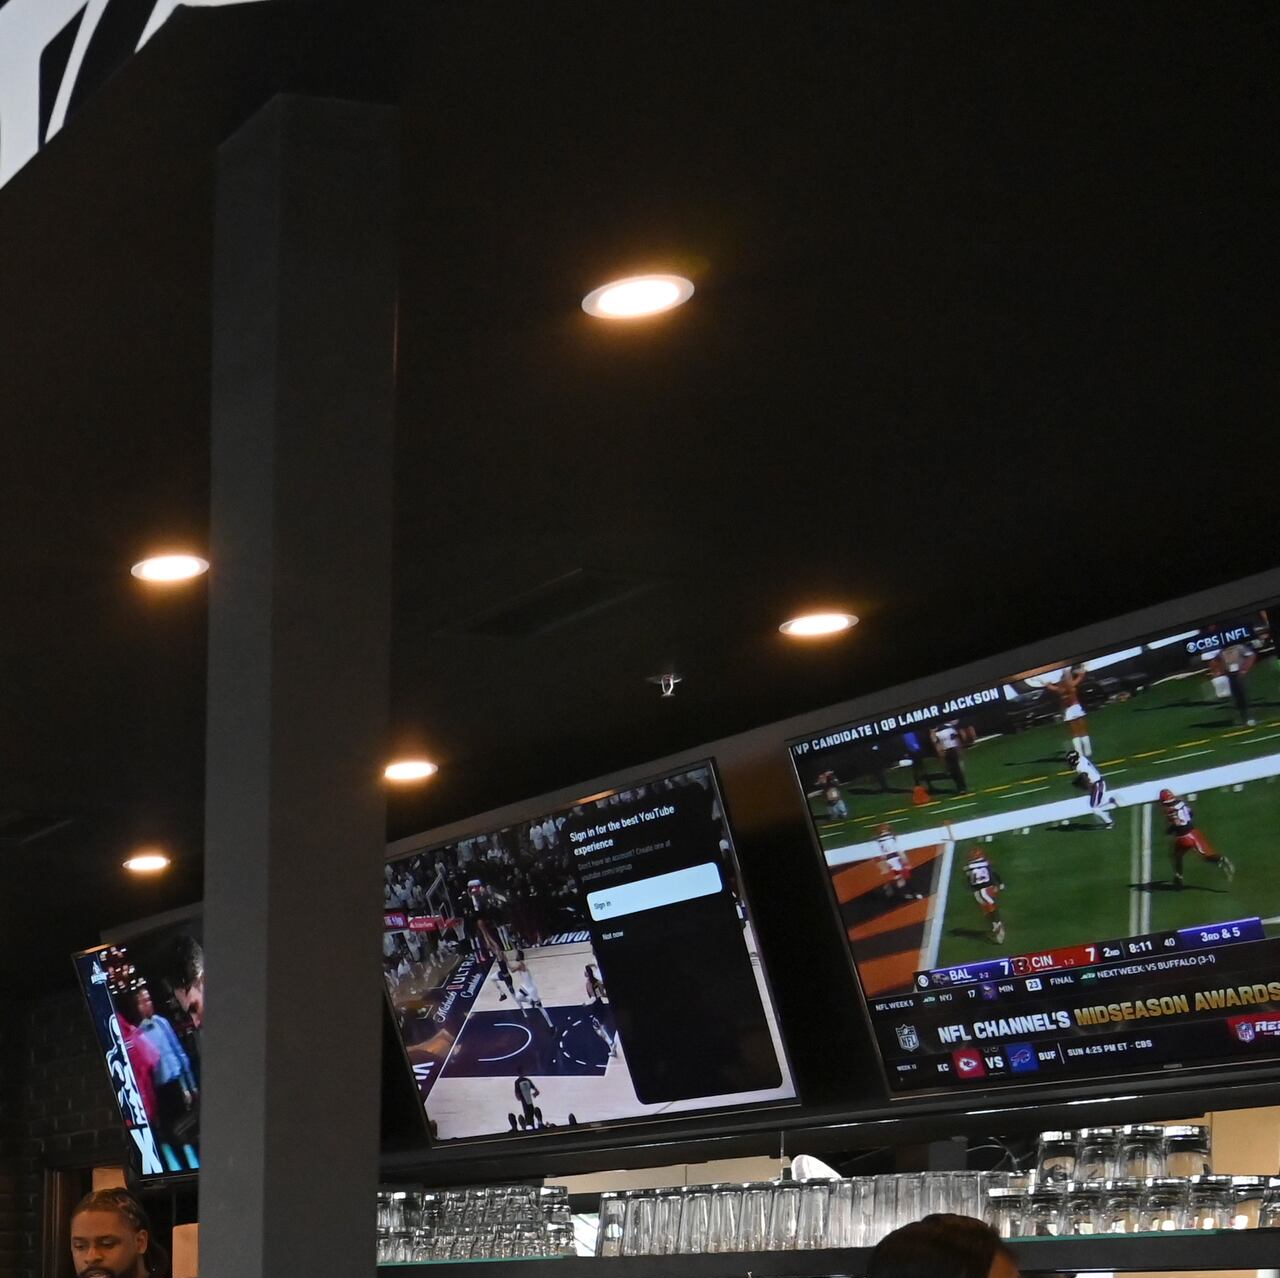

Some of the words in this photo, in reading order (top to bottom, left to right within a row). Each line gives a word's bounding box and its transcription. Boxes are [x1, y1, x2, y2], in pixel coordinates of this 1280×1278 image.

[1196, 635, 1219, 650] CBS
[1225, 627, 1250, 642] NFL
[812, 722, 873, 750] CANDIDATE
[880, 715, 897, 731] QB
[898, 704, 939, 727] LAMAR
[942, 687, 1000, 713] JACKSON
[570, 831, 587, 842] Sign
[587, 828, 596, 837] in
[595, 825, 607, 835] for
[607, 820, 621, 831] the
[621, 815, 639, 828] best
[639, 805, 675, 822] YouTube
[573, 838, 614, 857] experience
[1221, 928, 1232, 939] &
[1233, 926, 1241, 937] 5
[1128, 940, 1153, 954] 8:11
[1163, 937, 1176, 948] 40
[1031, 954, 1054, 969] CIN
[1085, 946, 1097, 963] 7
[1097, 968, 1120, 979] NEXT
[1145, 961, 1158, 972] VS
[1157, 956, 1198, 971] BUFFALO
[1198, 953, 1217, 966] (3-1)
[949, 966, 972, 982] BAL
[999, 960, 1011, 976] 7
[998, 984, 1014, 994] MIN
[1050, 975, 1075, 987] FINAL
[967, 989, 977, 999] 17
[875, 1001, 889, 1012] NFL
[889, 1000, 910, 1010] WEEK
[1074, 994, 1190, 1026] MIDSEASON
[1195, 982, 1280, 1011] AWARDS
[938, 1025, 972, 1044] NFL
[974, 1011, 1071, 1039] CHANNEL'S
[1038, 1049, 1057, 1061] BUF
[1067, 1047, 1085, 1058] SUN
[1084, 1044, 1103, 1055] 4:25
[1103, 1042, 1118, 1053] PM
[1117, 1041, 1128, 1051] ET
[1135, 1039, 1154, 1049] CBS
[937, 1063, 950, 1073] KC
[985, 1055, 1004, 1069] VS
